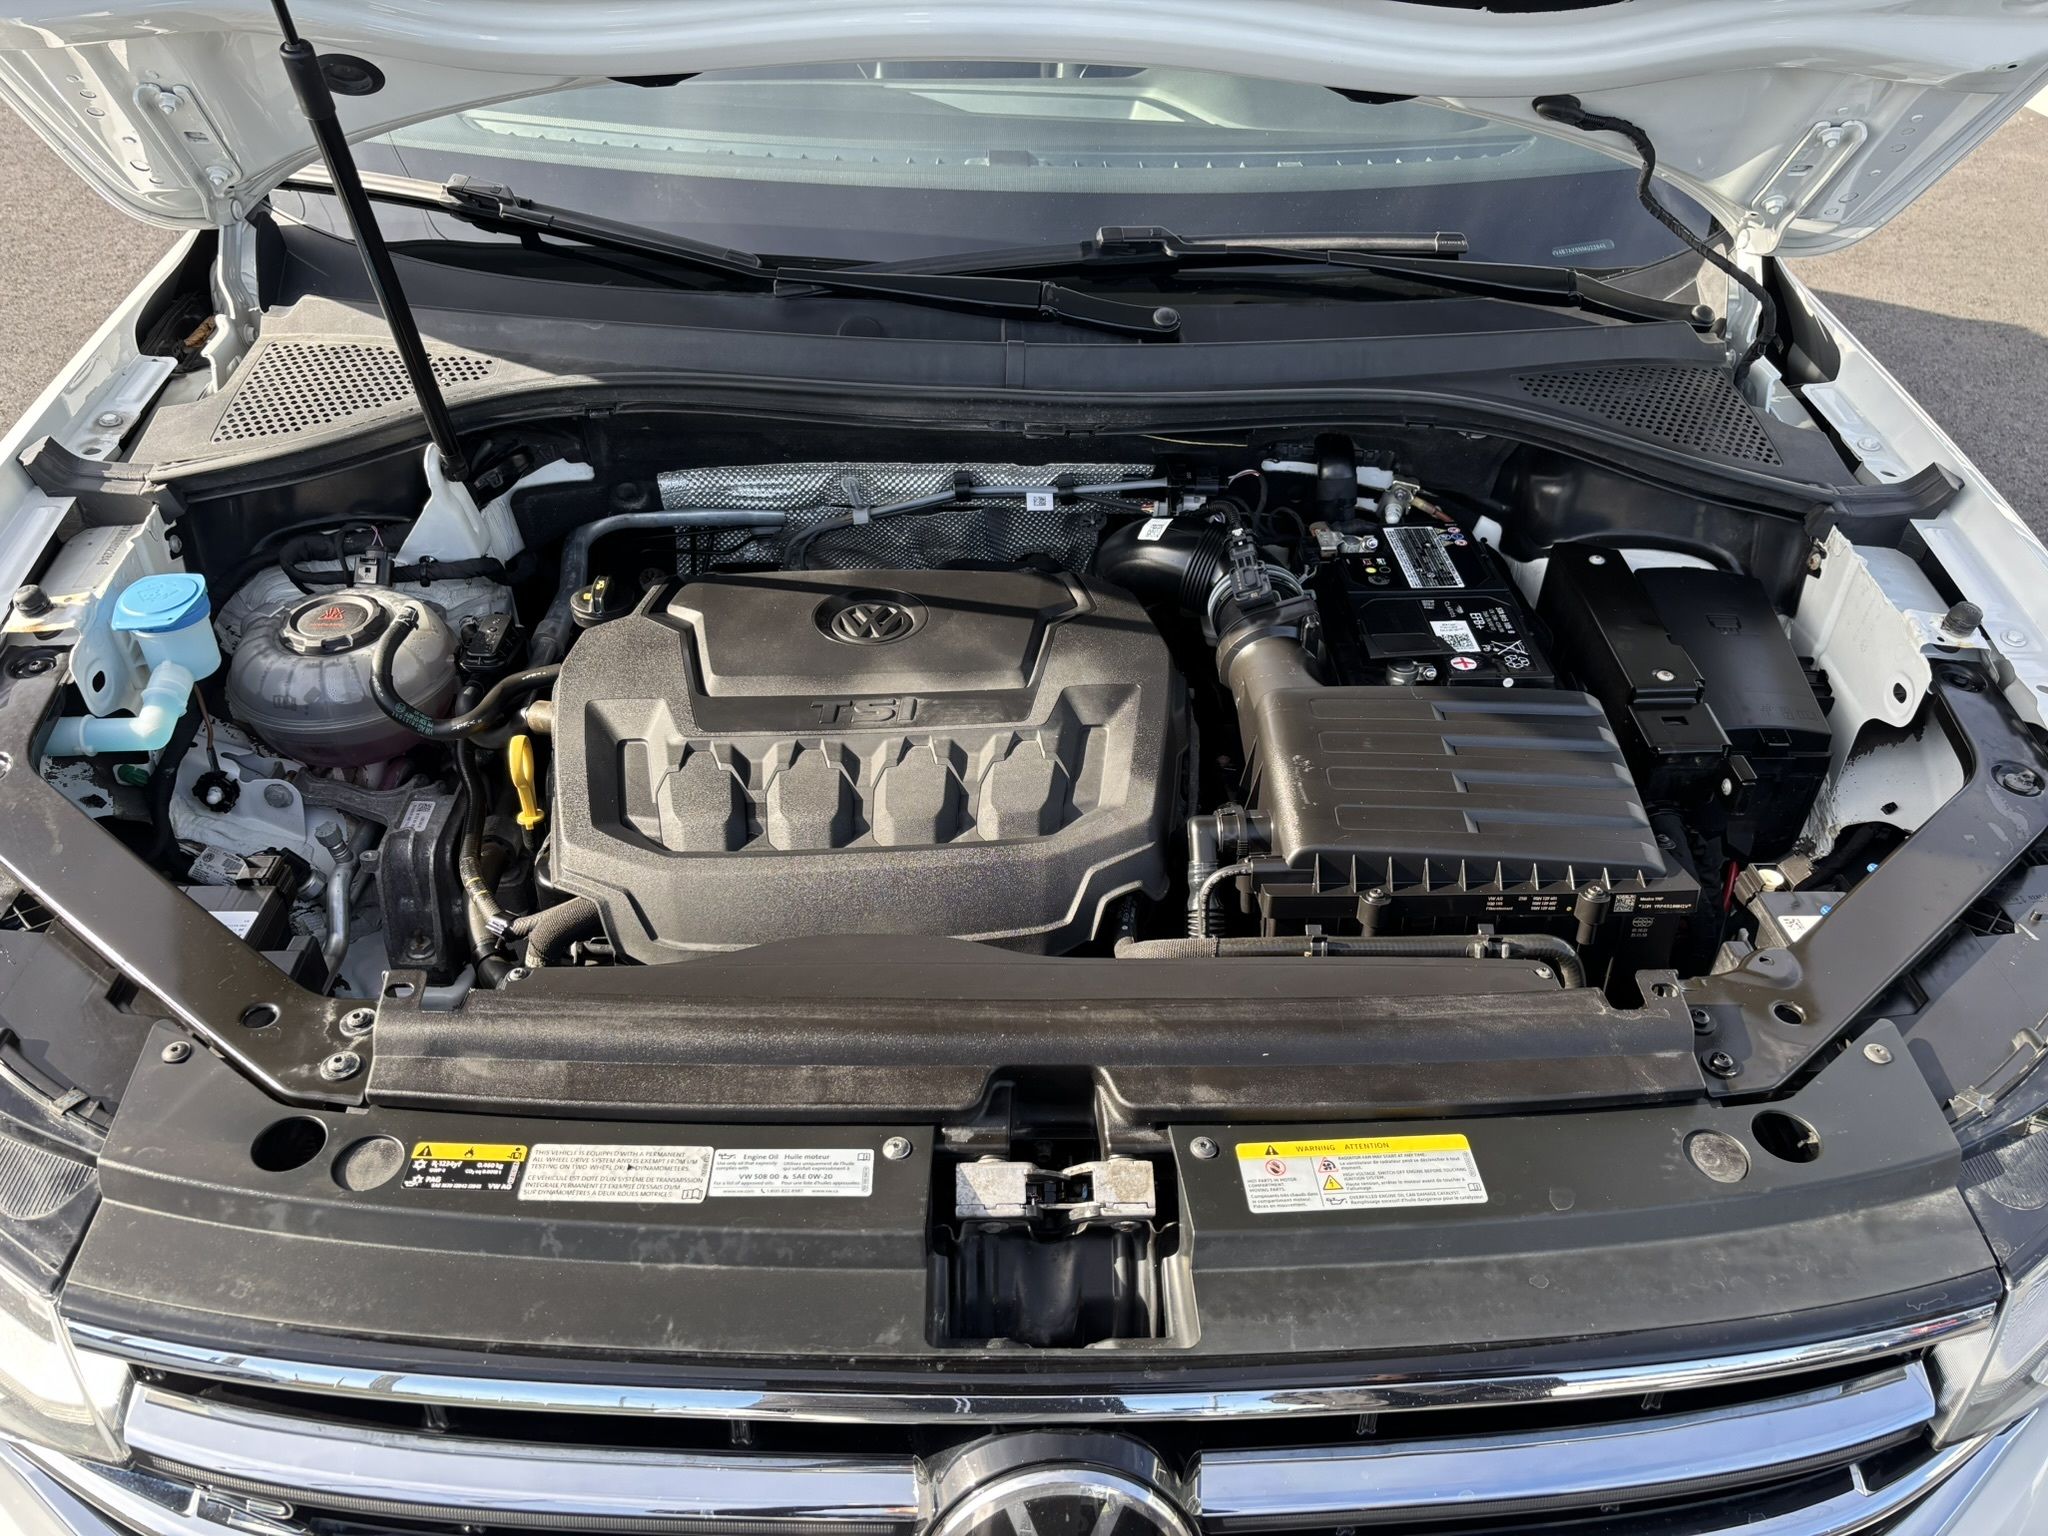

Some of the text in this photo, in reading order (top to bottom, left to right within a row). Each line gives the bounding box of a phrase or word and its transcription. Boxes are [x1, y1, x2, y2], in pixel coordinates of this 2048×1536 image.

[831, 603, 916, 642] VW
[1469, 612, 1486, 630] EFB+
[811, 698, 917, 724] TSI
[1344, 1142, 1389, 1150] ATTENTION
